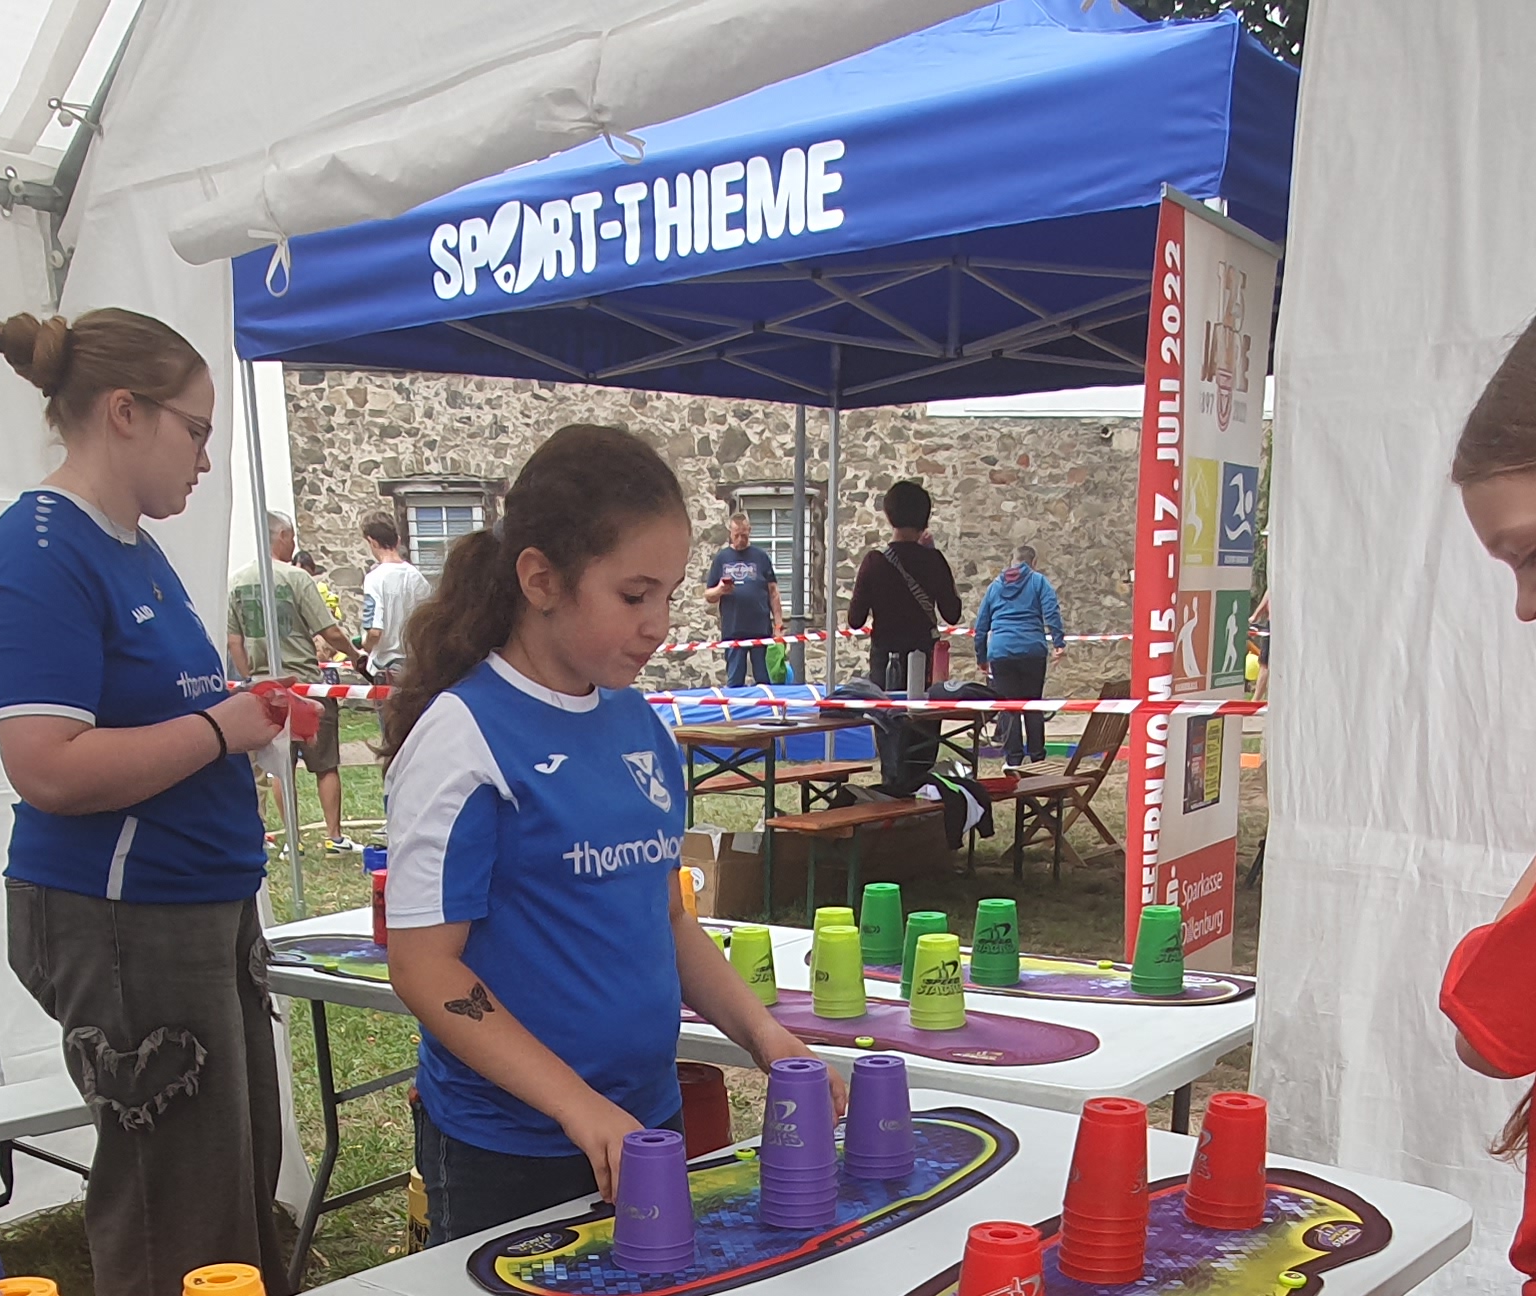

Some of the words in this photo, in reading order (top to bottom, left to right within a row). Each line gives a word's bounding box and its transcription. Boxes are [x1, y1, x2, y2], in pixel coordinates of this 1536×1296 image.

[1160, 239, 1181, 365] 2022
[1156, 377, 1180, 467] JULI
[1152, 477, 1179, 547] 17.
[1181, 870, 1224, 911] Sparkasse
